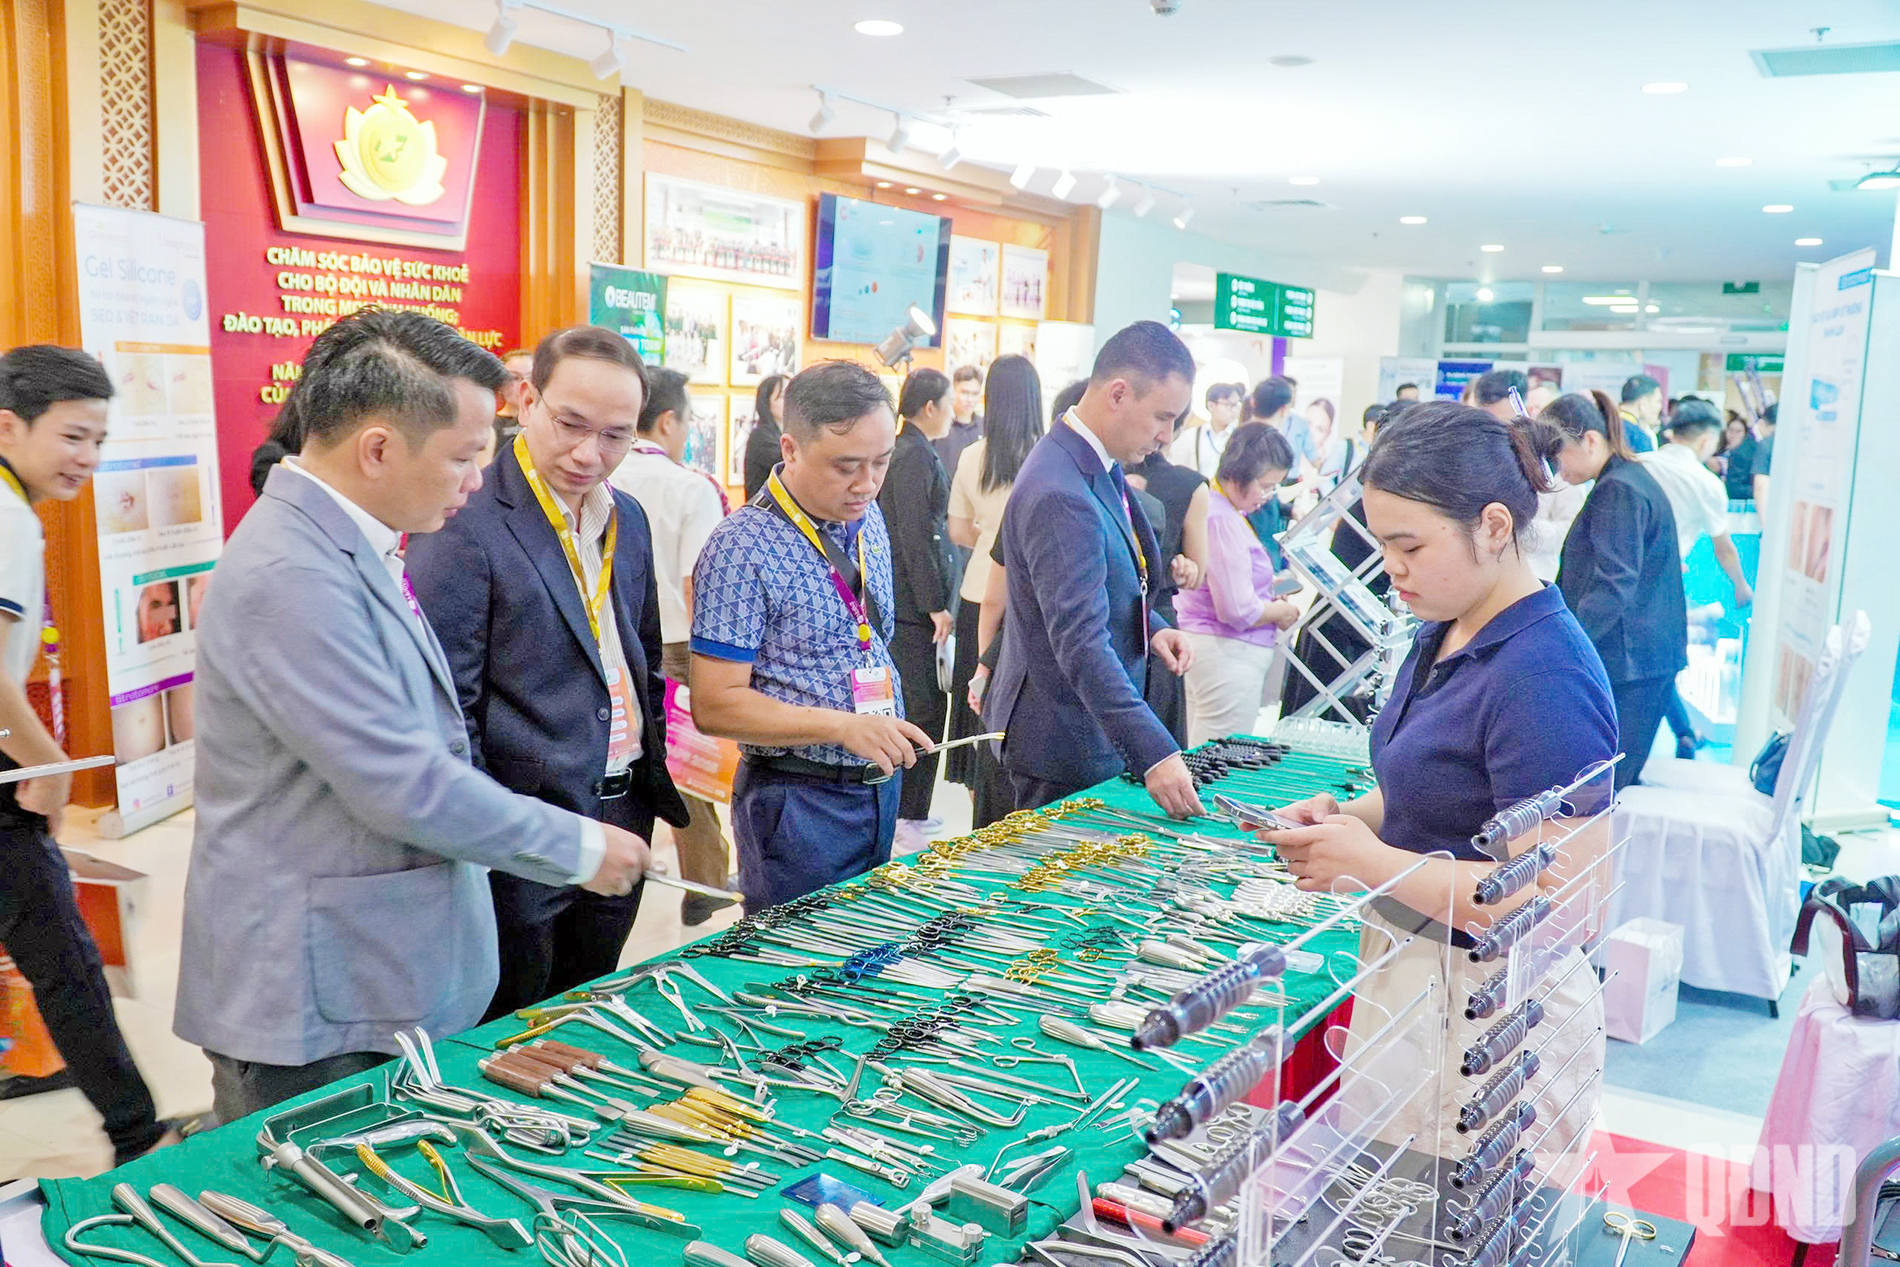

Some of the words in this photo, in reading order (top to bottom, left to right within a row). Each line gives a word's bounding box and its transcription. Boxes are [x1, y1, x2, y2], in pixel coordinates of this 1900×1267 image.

[85, 255, 112, 278] Gel
[117, 259, 176, 285] Silicone
[266, 246, 315, 267] CHĂM
[317, 251, 349, 272] SÓC
[350, 253, 381, 275] BẢO
[382, 257, 401, 280] VỆ
[402, 260, 432, 280] SỨC
[432, 263, 469, 284] KHOẺ
[278, 272, 313, 291] CHO
[315, 273, 338, 296] BỘ
[339, 275, 367, 299] ĐỘI
[368, 278, 389, 297] VÀ
[389, 281, 431, 301] NHÂN
[432, 284, 462, 303] DÂN
[281, 295, 337, 316] TRONG
[223, 312, 262, 333] ĐÀO
[262, 317, 300, 338] TẠO,
[477, 329, 503, 349] LỰC
